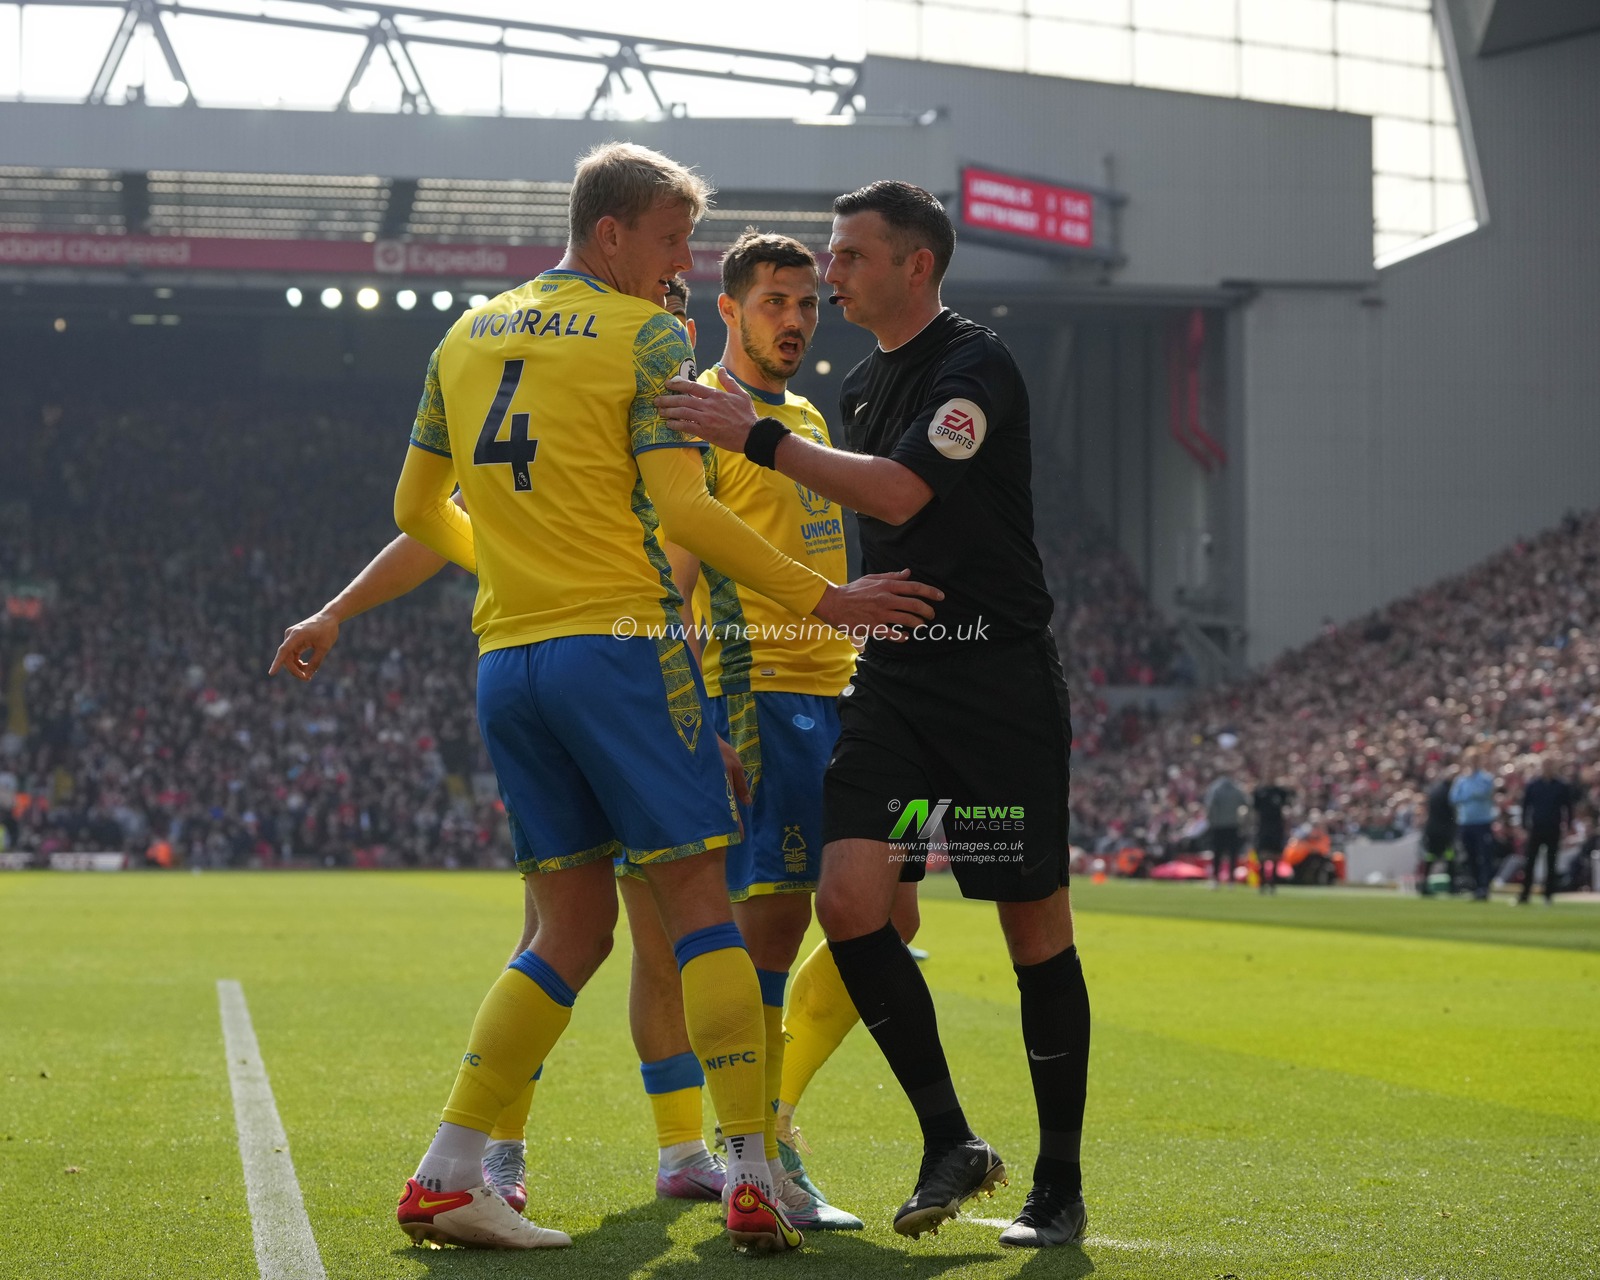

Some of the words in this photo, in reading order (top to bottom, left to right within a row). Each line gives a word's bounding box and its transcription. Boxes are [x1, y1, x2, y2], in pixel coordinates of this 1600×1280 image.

[408, 245, 507, 273] Expedia
[469, 308, 599, 339] WORRALL
[472, 358, 539, 492] 4
[935, 425, 975, 450] SPORTS
[940, 408, 976, 441] EA
[800, 519, 842, 540] UNHCR
[785, 862, 807, 874] FOREST
[705, 1051, 758, 1071] NFFC
